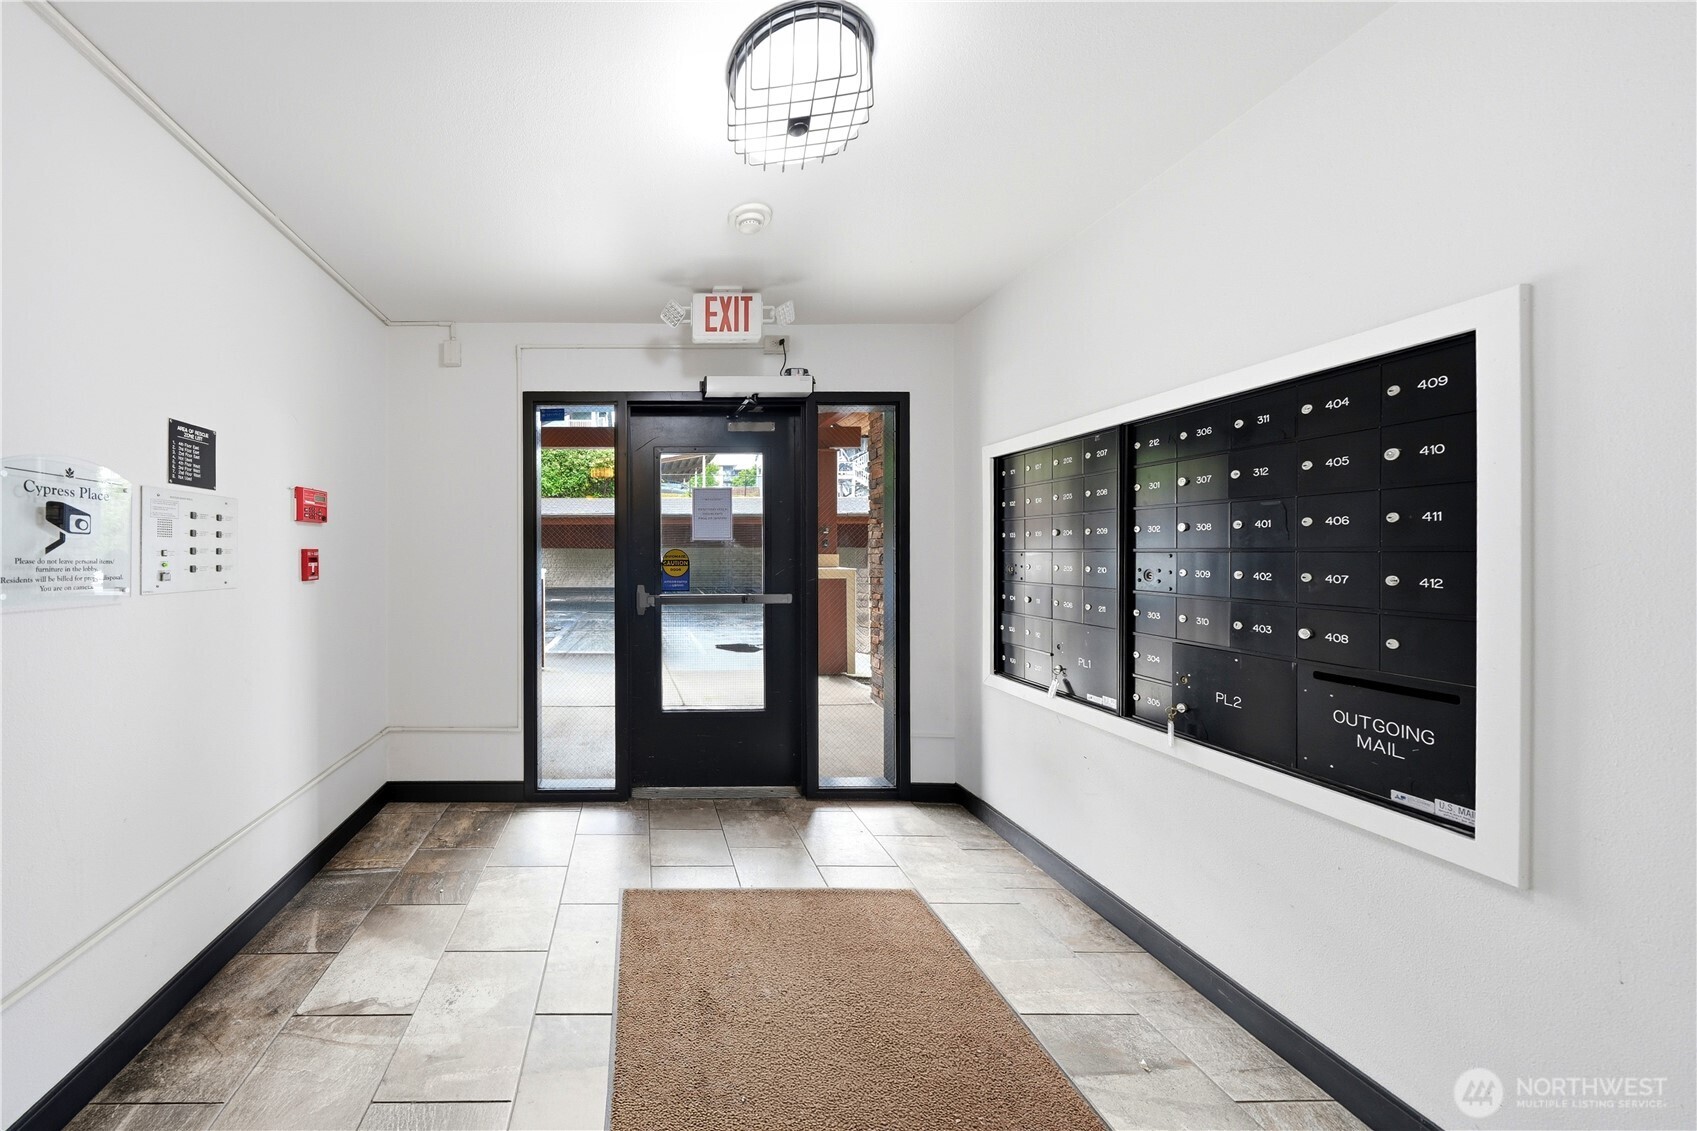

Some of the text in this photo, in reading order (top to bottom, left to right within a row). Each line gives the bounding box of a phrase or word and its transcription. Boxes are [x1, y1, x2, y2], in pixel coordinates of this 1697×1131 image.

[705, 296, 753, 332] EXIT
[1418, 376, 1448, 389] 409
[1326, 397, 1349, 409] 404
[1258, 415, 1269, 424] 311
[1196, 427, 1212, 436] 306
[1149, 439, 1159, 447] 212
[1097, 449, 1107, 457] 207
[1420, 444, 1445, 455] 410
[1326, 456, 1349, 467] 405
[1253, 467, 1268, 476] 312
[1196, 475, 1211, 484] 307
[23, 479, 110, 501] Cypress Place
[1325, 516, 1349, 525] 406
[1422, 512, 1441, 521] 411
[1196, 523, 1211, 531] 308
[1255, 520, 1271, 528] 401
[1195, 570, 1210, 578] 309
[1253, 572, 1272, 580] 402
[0, 576, 33, 584] Residents
[1325, 575, 1349, 583] 407
[1420, 578, 1443, 588] 412
[1196, 617, 1209, 625] 310
[1253, 625, 1272, 633] 403
[1325, 633, 1348, 643] 408
[1078, 658, 1091, 668] PL1
[1147, 655, 1160, 663] 304
[1147, 697, 1161, 708] 305
[1216, 692, 1241, 708] PL2
[1333, 709, 1435, 745] OUTGOING
[1357, 734, 1406, 760] MAIL
[1439, 801, 1456, 813] U.S.
